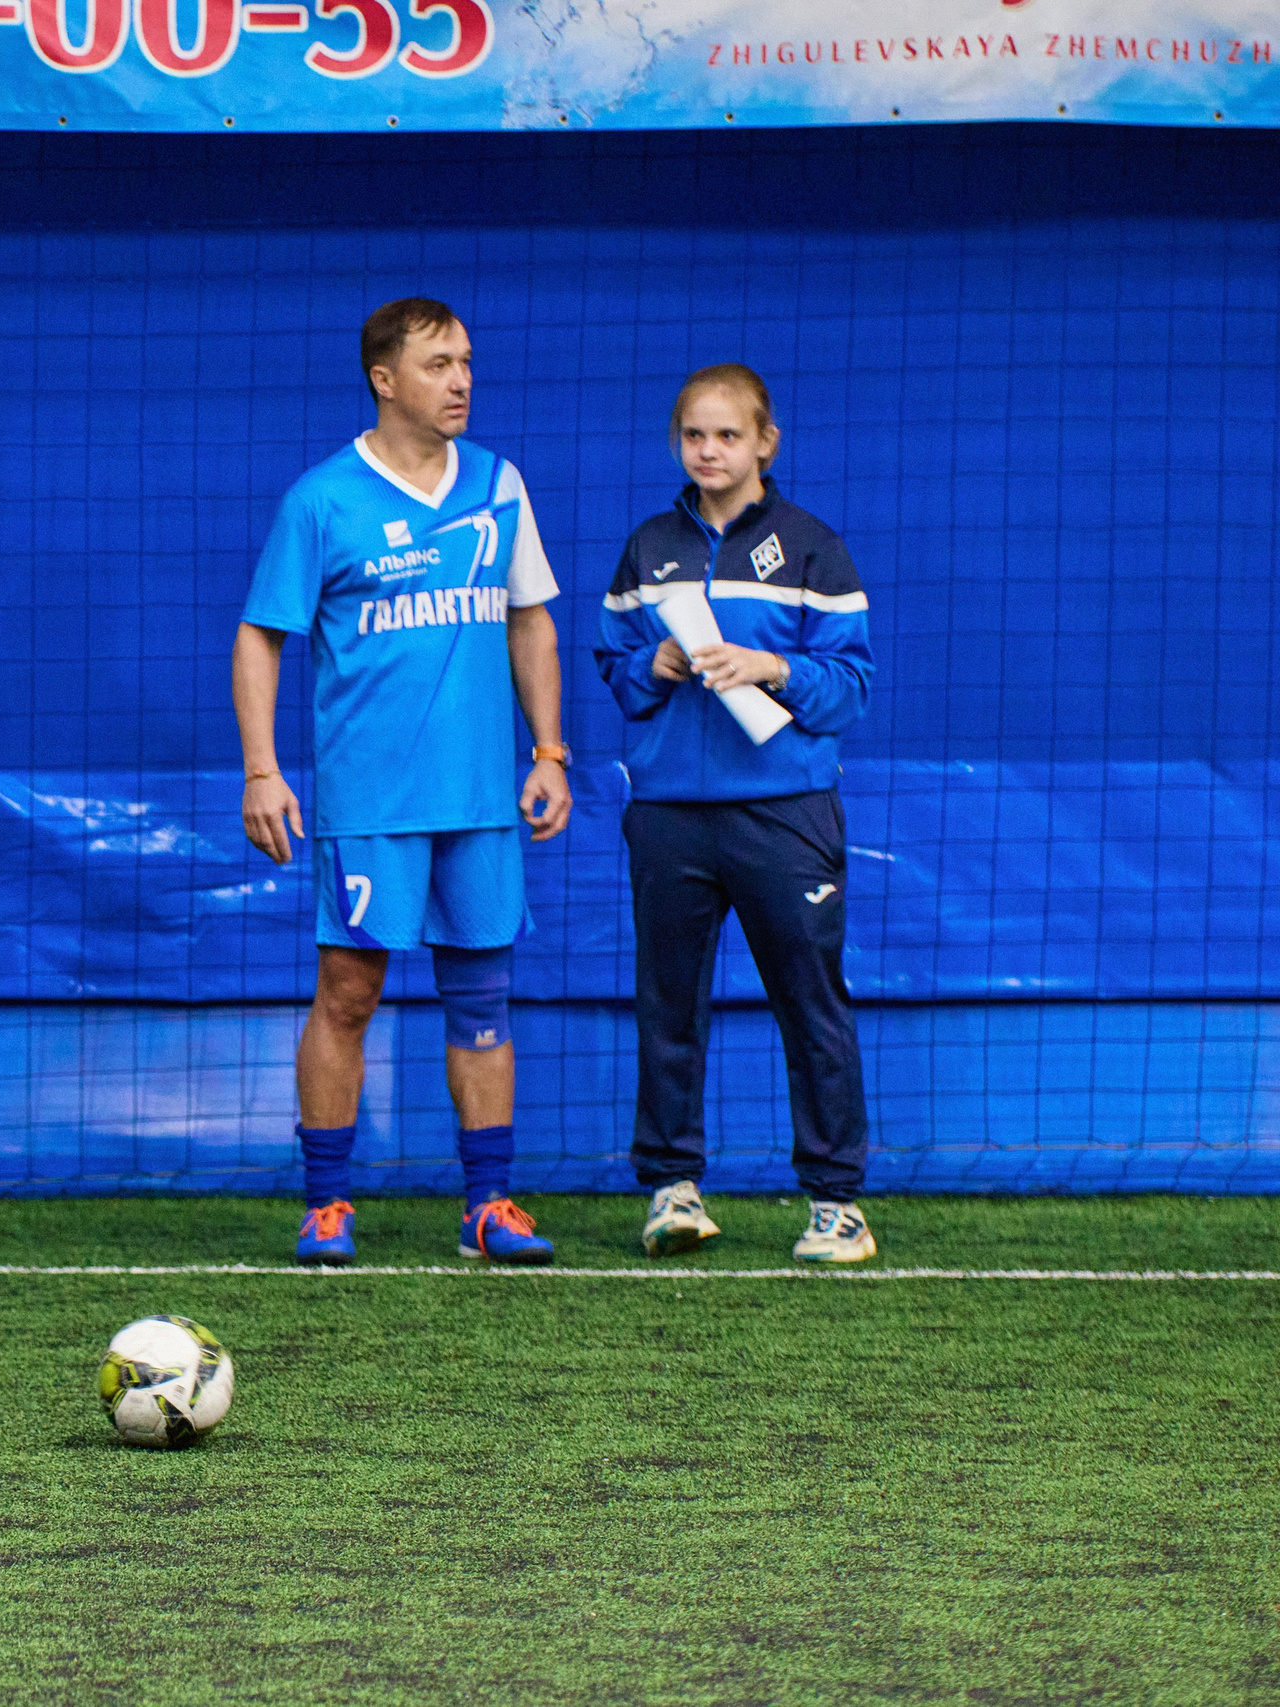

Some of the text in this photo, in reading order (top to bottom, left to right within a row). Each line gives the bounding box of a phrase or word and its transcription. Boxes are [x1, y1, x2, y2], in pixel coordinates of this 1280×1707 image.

[708, 33, 1273, 67] ZHIGULEVSKAYA ZHEMCHUZH
[471, 514, 499, 567] 7
[364, 548, 442, 577] АЛЬЯНС
[345, 874, 372, 928] 7
